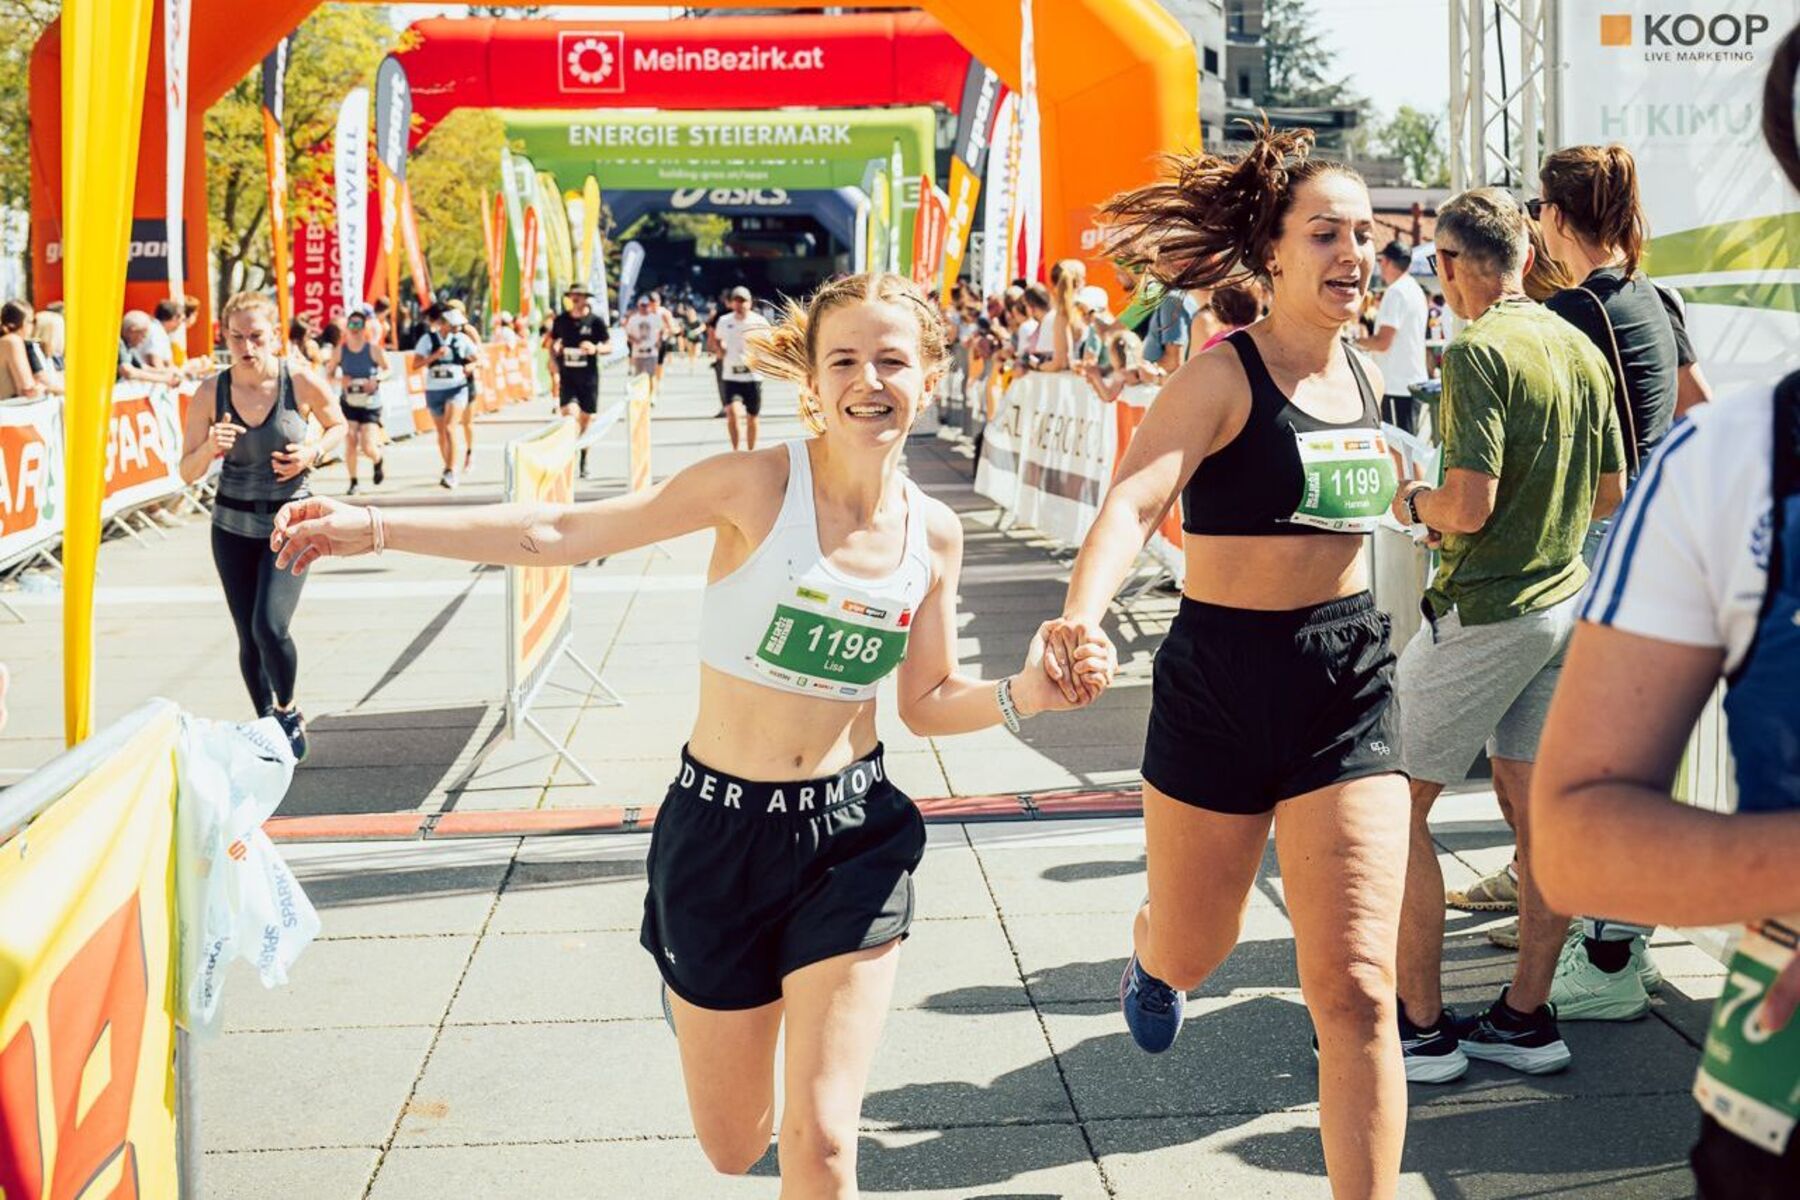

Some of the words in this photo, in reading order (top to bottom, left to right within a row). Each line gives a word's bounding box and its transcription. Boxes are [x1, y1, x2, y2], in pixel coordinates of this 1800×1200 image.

[1644, 13, 1769, 46] KOOP
[633, 46, 825, 71] MeinBezirk.at
[1644, 52, 1671, 62] LIVE
[1677, 52, 1754, 63] MARKETING
[569, 124, 679, 146] ENERGIE
[689, 123, 851, 146] STEIERMARK
[1601, 103, 1752, 137] HIKIMU
[305, 218, 325, 274] LIEB
[1331, 467, 1380, 496] 1199
[808, 624, 883, 664] 1198
[823, 659, 845, 673] Lisa
[679, 762, 744, 809] DER
[766, 756, 884, 814] ARMOU
